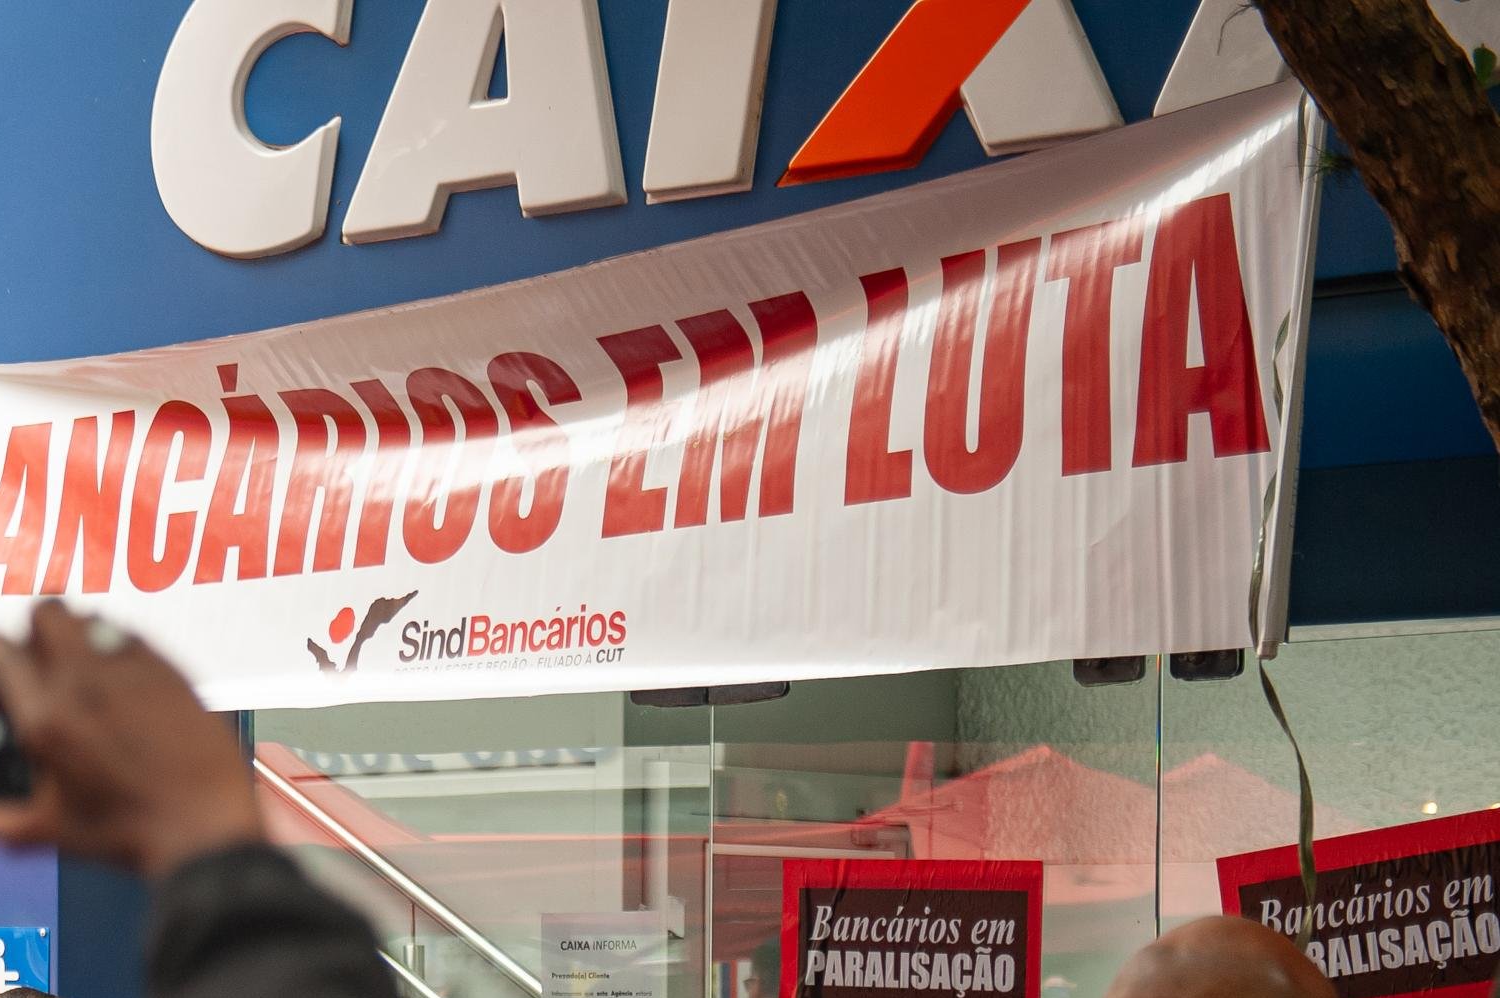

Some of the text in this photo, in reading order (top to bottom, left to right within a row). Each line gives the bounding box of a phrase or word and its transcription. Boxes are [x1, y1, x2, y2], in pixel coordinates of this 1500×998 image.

[151, 0, 1500, 258] CAIX
[597, 290, 818, 538] EM
[844, 193, 1271, 507] LUTA
[399, 604, 627, 663] SindBancários
[596, 648, 625, 663] CUT
[809, 905, 1016, 945] Bancários em
[1260, 874, 1494, 936] Bancários em
[560, 940, 637, 951] CAIXA INFORMA
[804, 946, 1016, 998] PARALISAÇÃO
[1306, 908, 1500, 979] RALISAÇÃO
